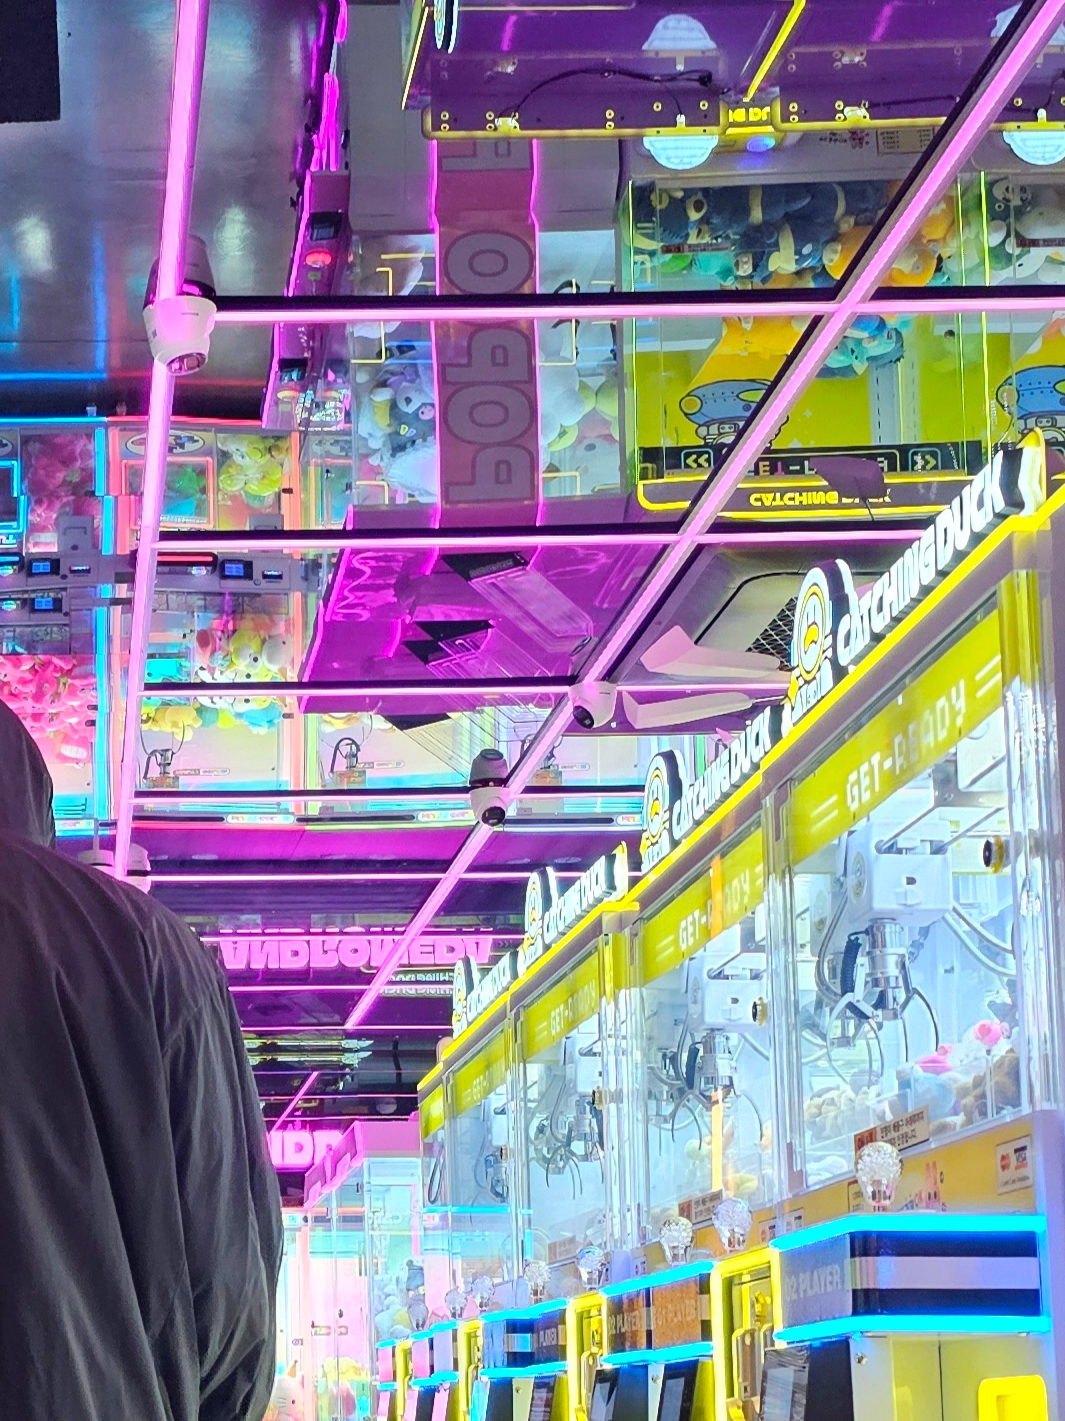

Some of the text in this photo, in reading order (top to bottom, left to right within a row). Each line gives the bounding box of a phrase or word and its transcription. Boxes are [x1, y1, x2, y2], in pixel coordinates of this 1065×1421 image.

[836, 524, 936, 667] CATCHING
[936, 449, 1006, 570] DUCK
[730, 705, 772, 785] DUCK
[845, 679, 967, 813] GET-READY
[798, 1263, 842, 1298] PLAYER
